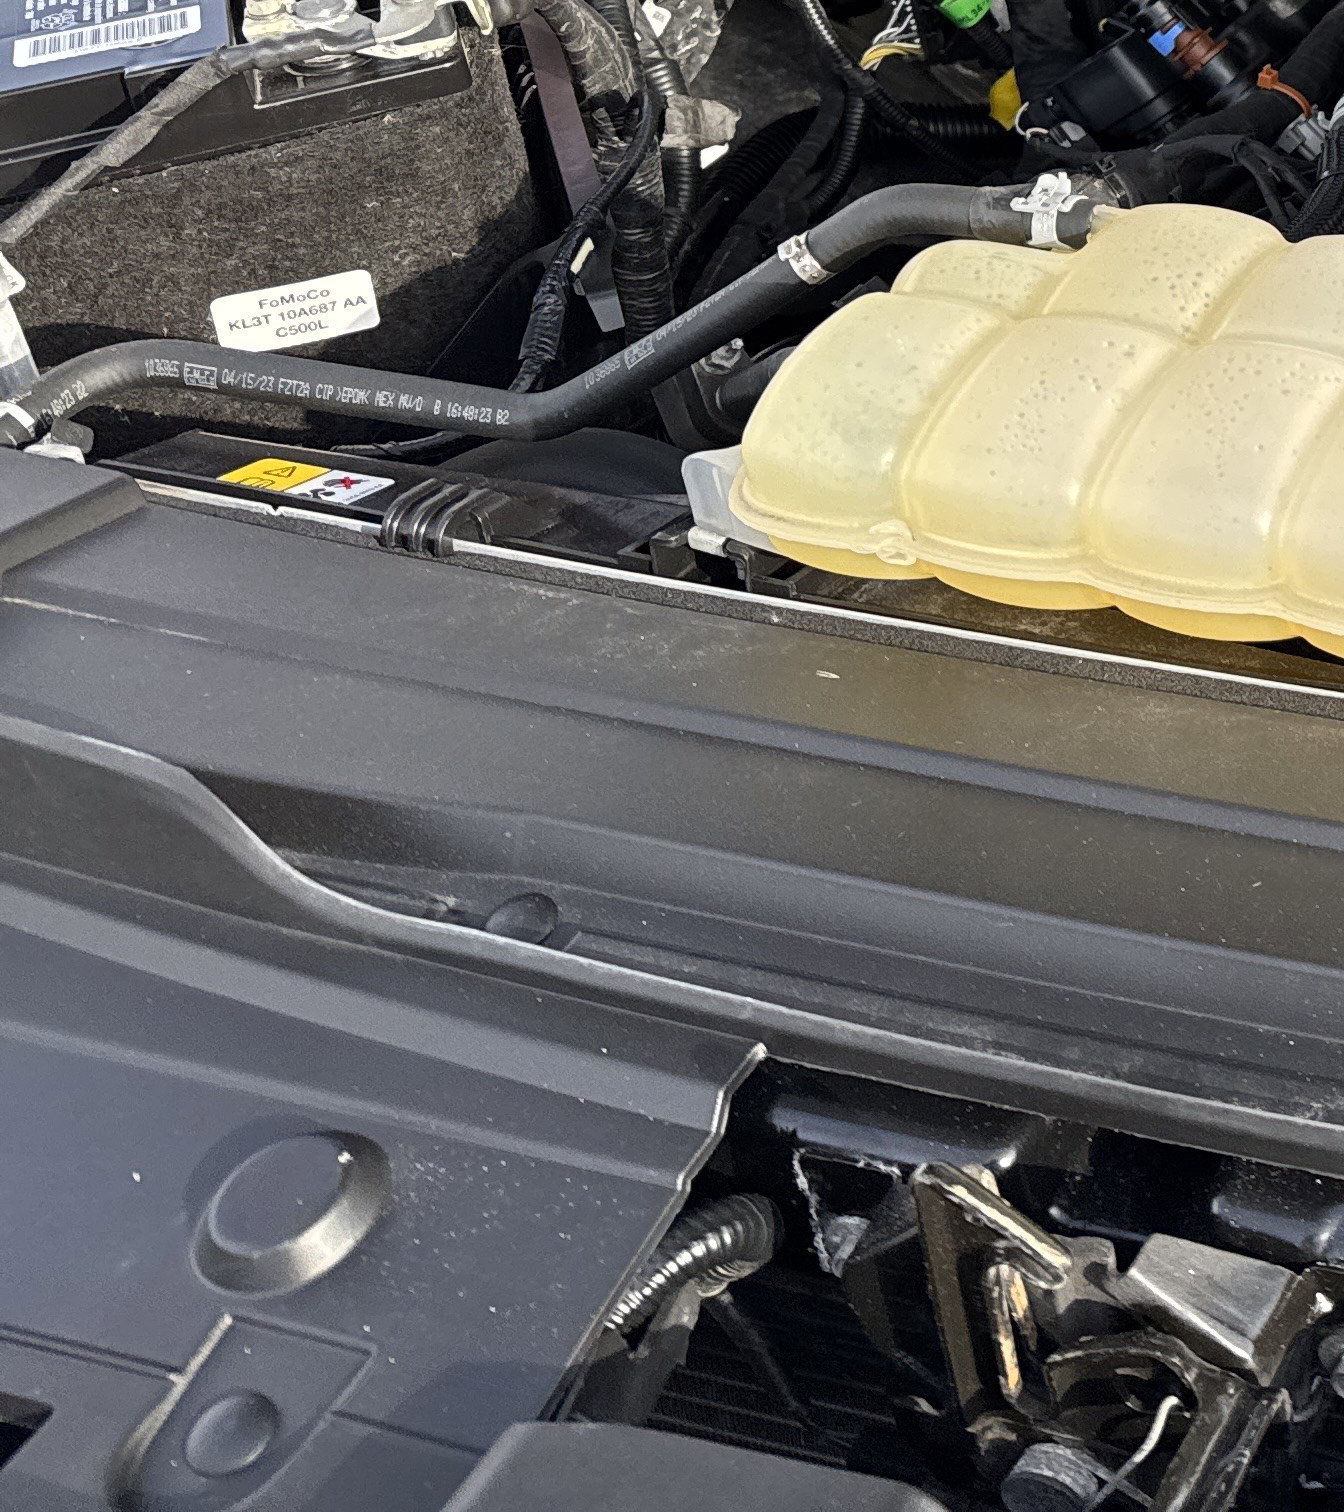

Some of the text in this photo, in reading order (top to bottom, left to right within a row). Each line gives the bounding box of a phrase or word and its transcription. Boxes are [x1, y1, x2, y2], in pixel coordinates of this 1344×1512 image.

[228, 295, 368, 332] KL3T 10A687 AA
[258, 289, 331, 310] FoMoCo
[275, 320, 329, 338] C500L
[221, 368, 275, 392] 04/15/23
[446, 402, 493, 423] 16:49:23
